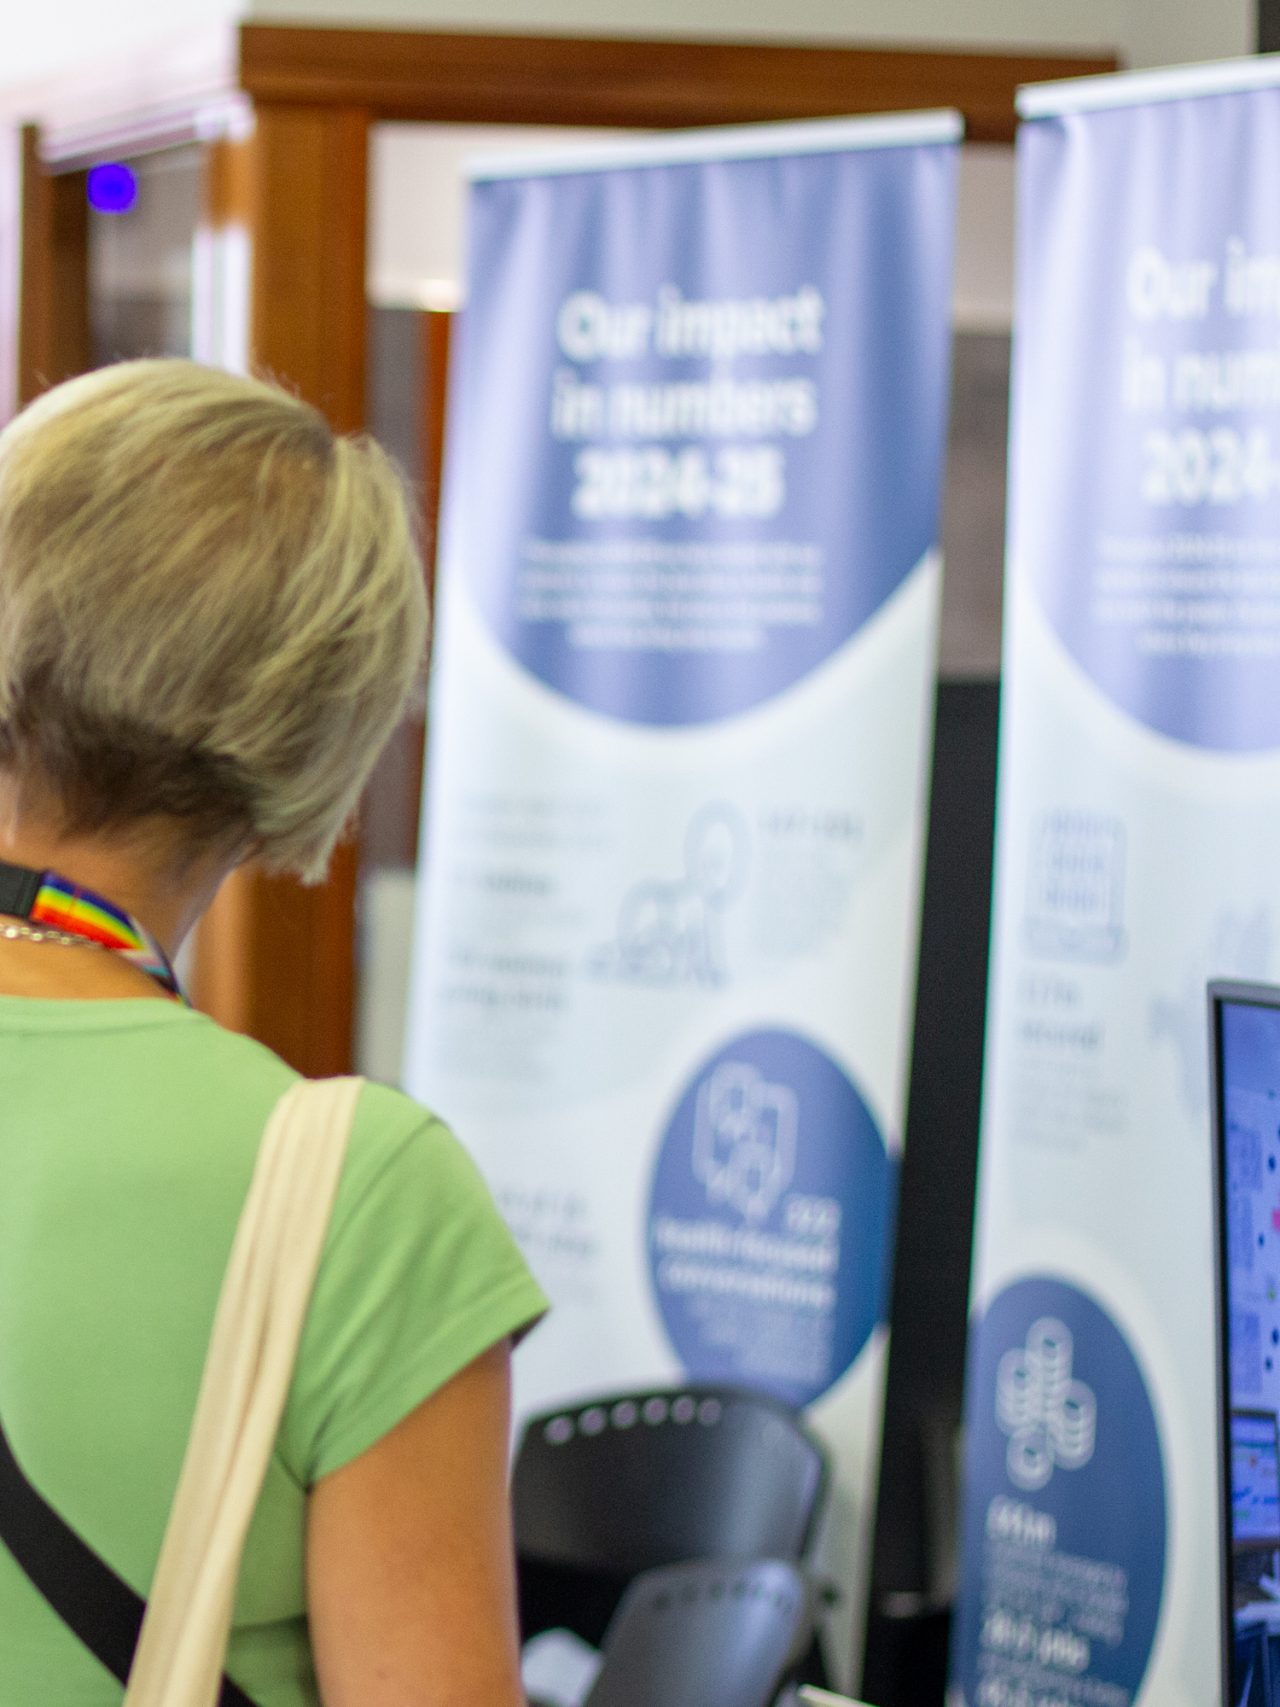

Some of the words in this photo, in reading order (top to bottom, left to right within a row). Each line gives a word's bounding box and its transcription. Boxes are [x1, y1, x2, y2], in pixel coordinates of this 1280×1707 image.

[1127, 246, 1215, 320] Our
[557, 290, 652, 363] Our
[656, 284, 824, 374] impact
[552, 366, 604, 441] in
[609, 370, 817, 438] numbers
